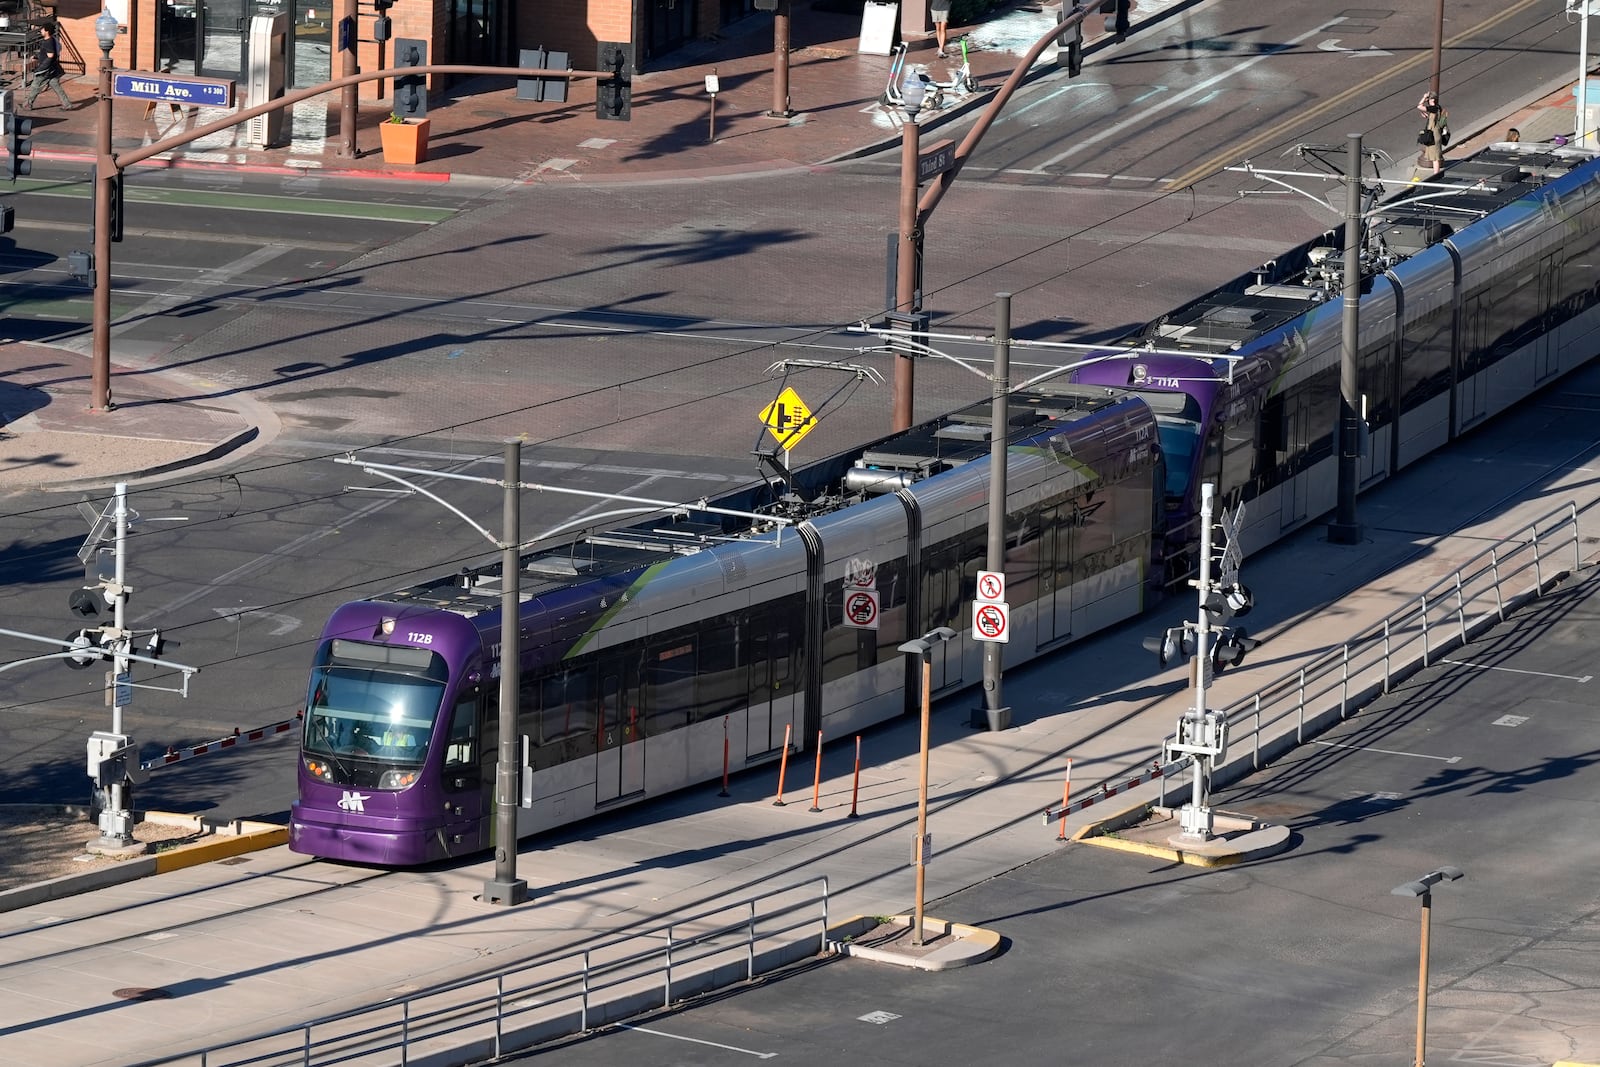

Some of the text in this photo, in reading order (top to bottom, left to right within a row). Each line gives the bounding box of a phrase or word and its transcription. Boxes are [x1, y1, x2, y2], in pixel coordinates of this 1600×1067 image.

[130, 80, 160, 94] Mill
[164, 84, 192, 97] Ave.
[921, 153, 946, 176] Third St
[1158, 378, 1179, 388] 111A
[407, 632, 433, 645] 112B
